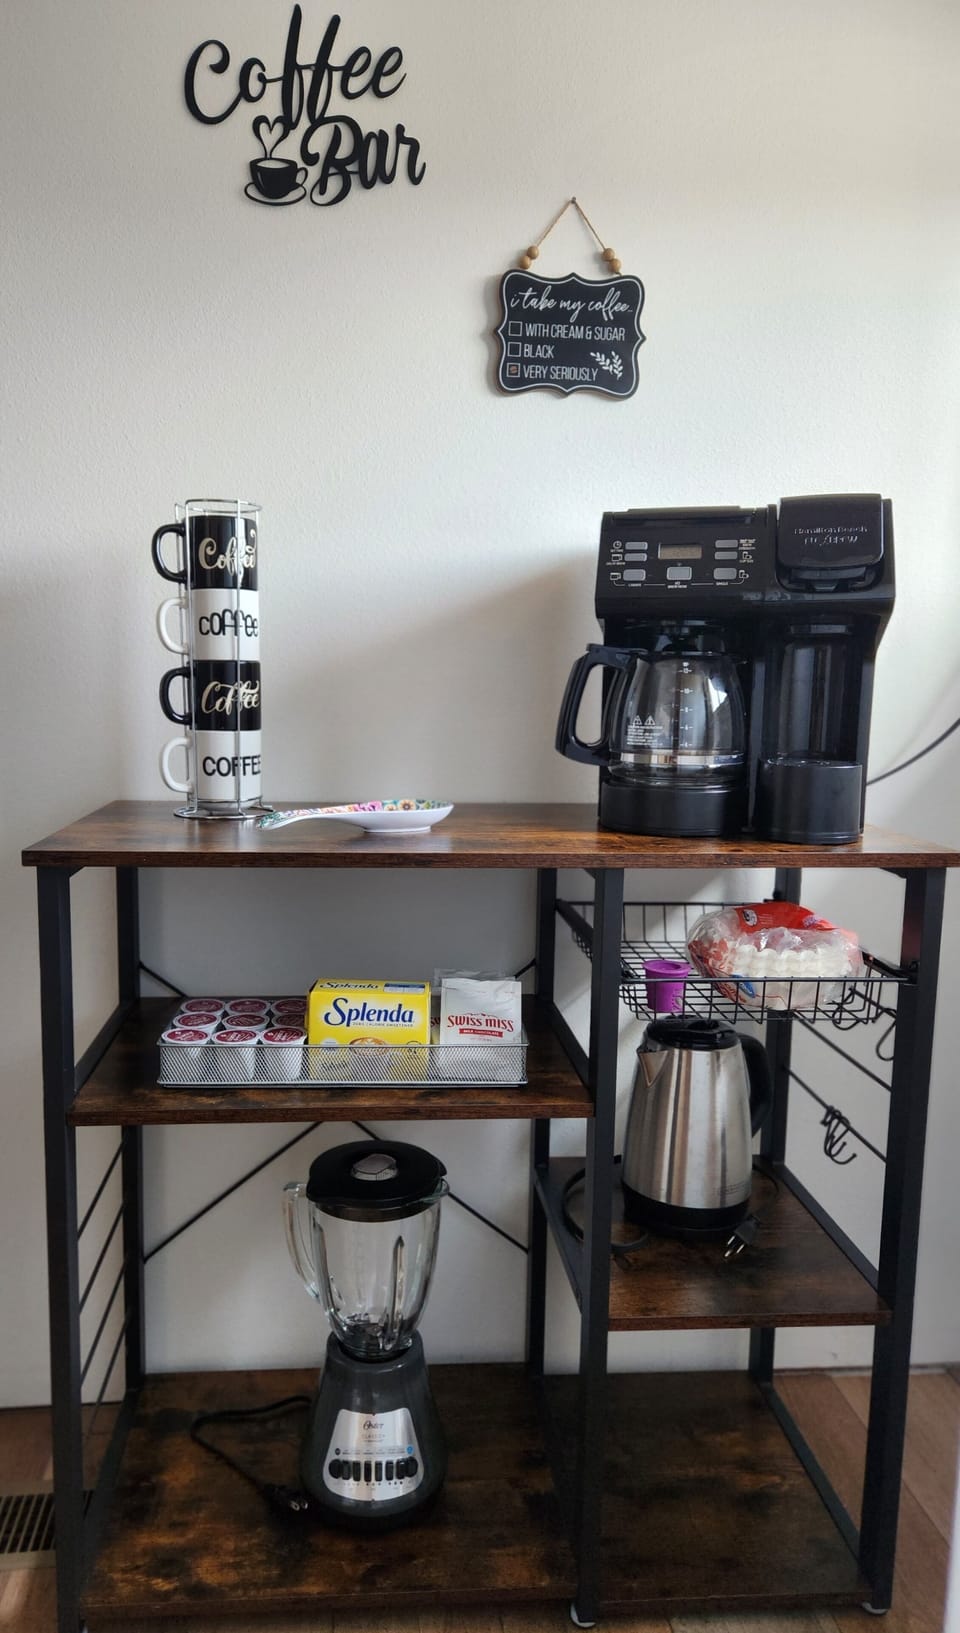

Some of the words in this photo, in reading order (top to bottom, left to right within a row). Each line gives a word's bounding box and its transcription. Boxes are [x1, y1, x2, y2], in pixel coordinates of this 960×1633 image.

[184, 3, 407, 130] Coffee
[300, 115, 426, 206] Bar
[518, 285, 557, 311] take
[559, 297, 586, 323] my
[525, 323, 549, 338] WITH
[550, 325, 584, 340] CREAM
[585, 327, 592, 339] &
[593, 327, 625, 341] SUGAR
[523, 344, 555, 359] BLACK
[523, 364, 548, 379] VERY
[549, 366, 599, 381] SERIOUSLY
[324, 997, 414, 1027] Splenda
[447, 1015, 482, 1028] SWISS
[485, 1018, 514, 1032] MISS
